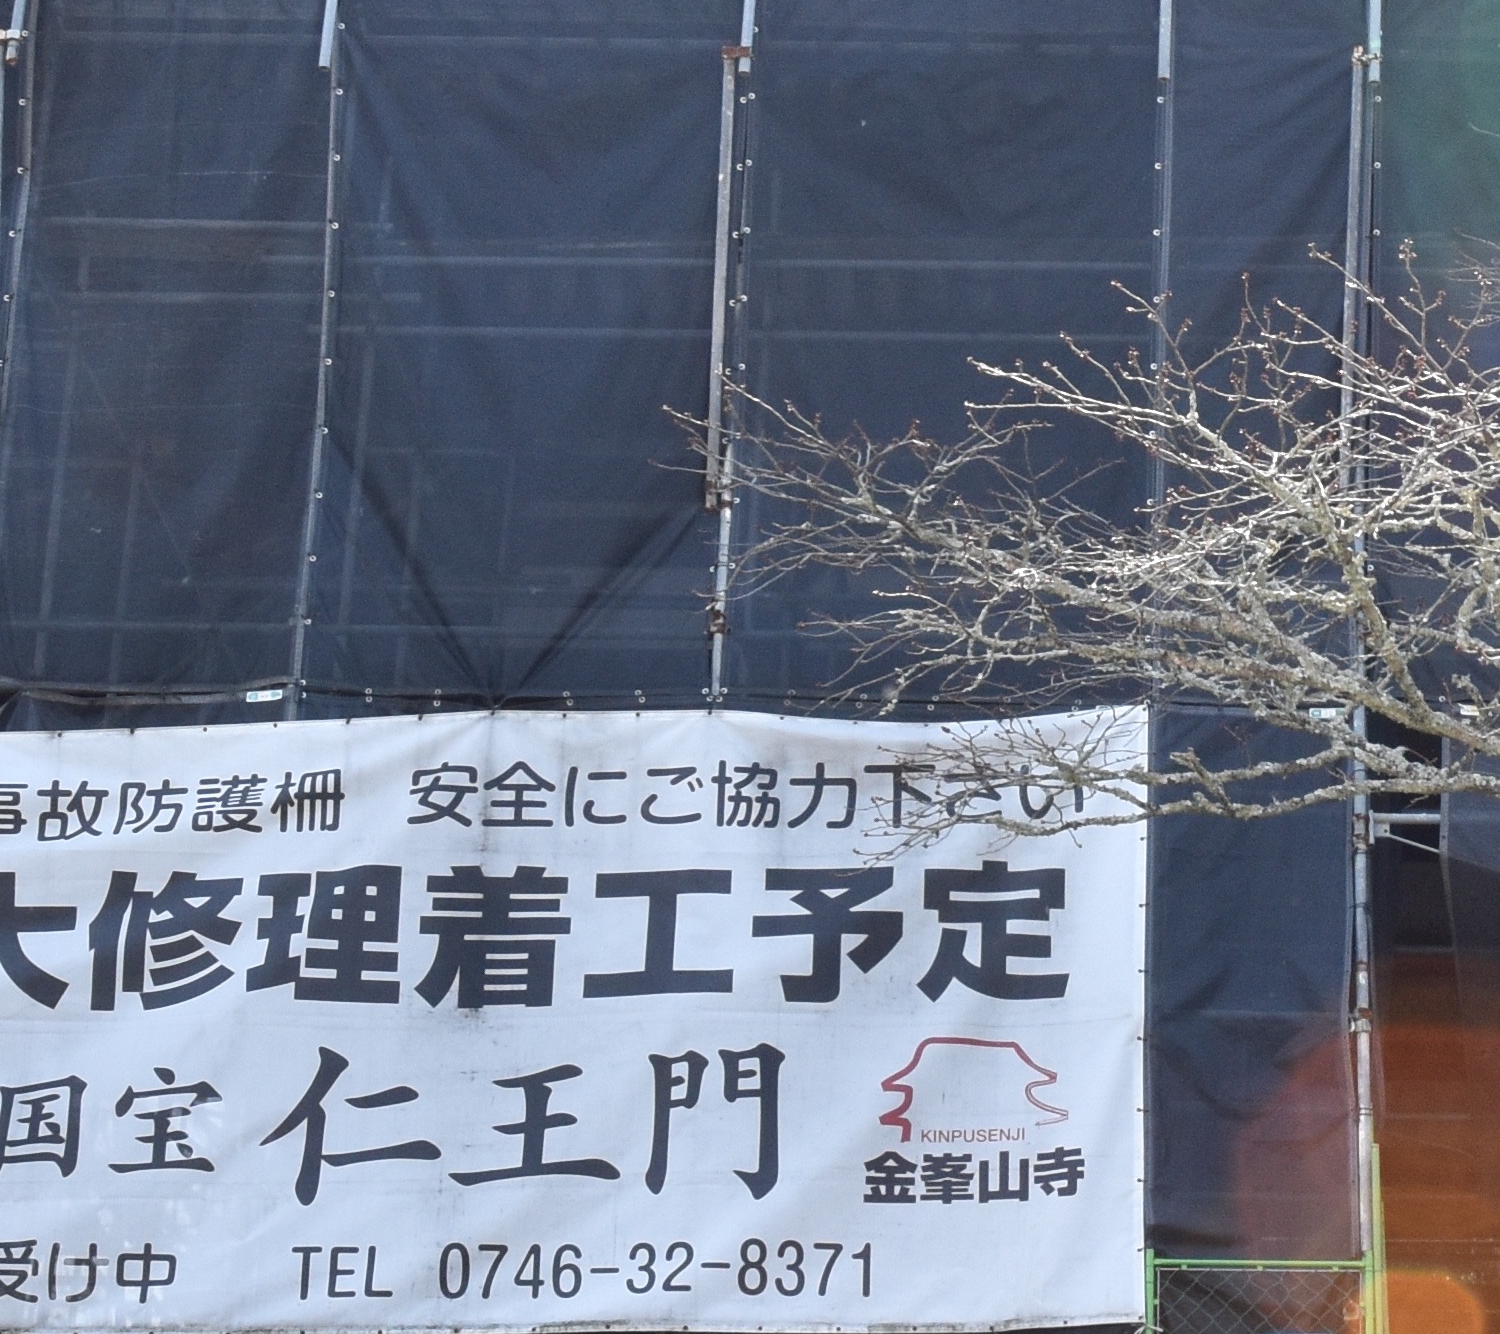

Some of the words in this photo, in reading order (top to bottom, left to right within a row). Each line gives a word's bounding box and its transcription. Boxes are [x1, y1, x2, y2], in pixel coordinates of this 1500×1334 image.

[409, 759, 1084, 830] 安全にご協力下さい
[260, 1042, 785, 1206] 仁王門
[920, 1127, 1026, 1144] KINPUSENJI
[863, 1146, 1086, 1205] 金峯山寺
[292, 1244, 393, 1301] TEL
[438, 1239, 873, 1300] 0746-32-8371
